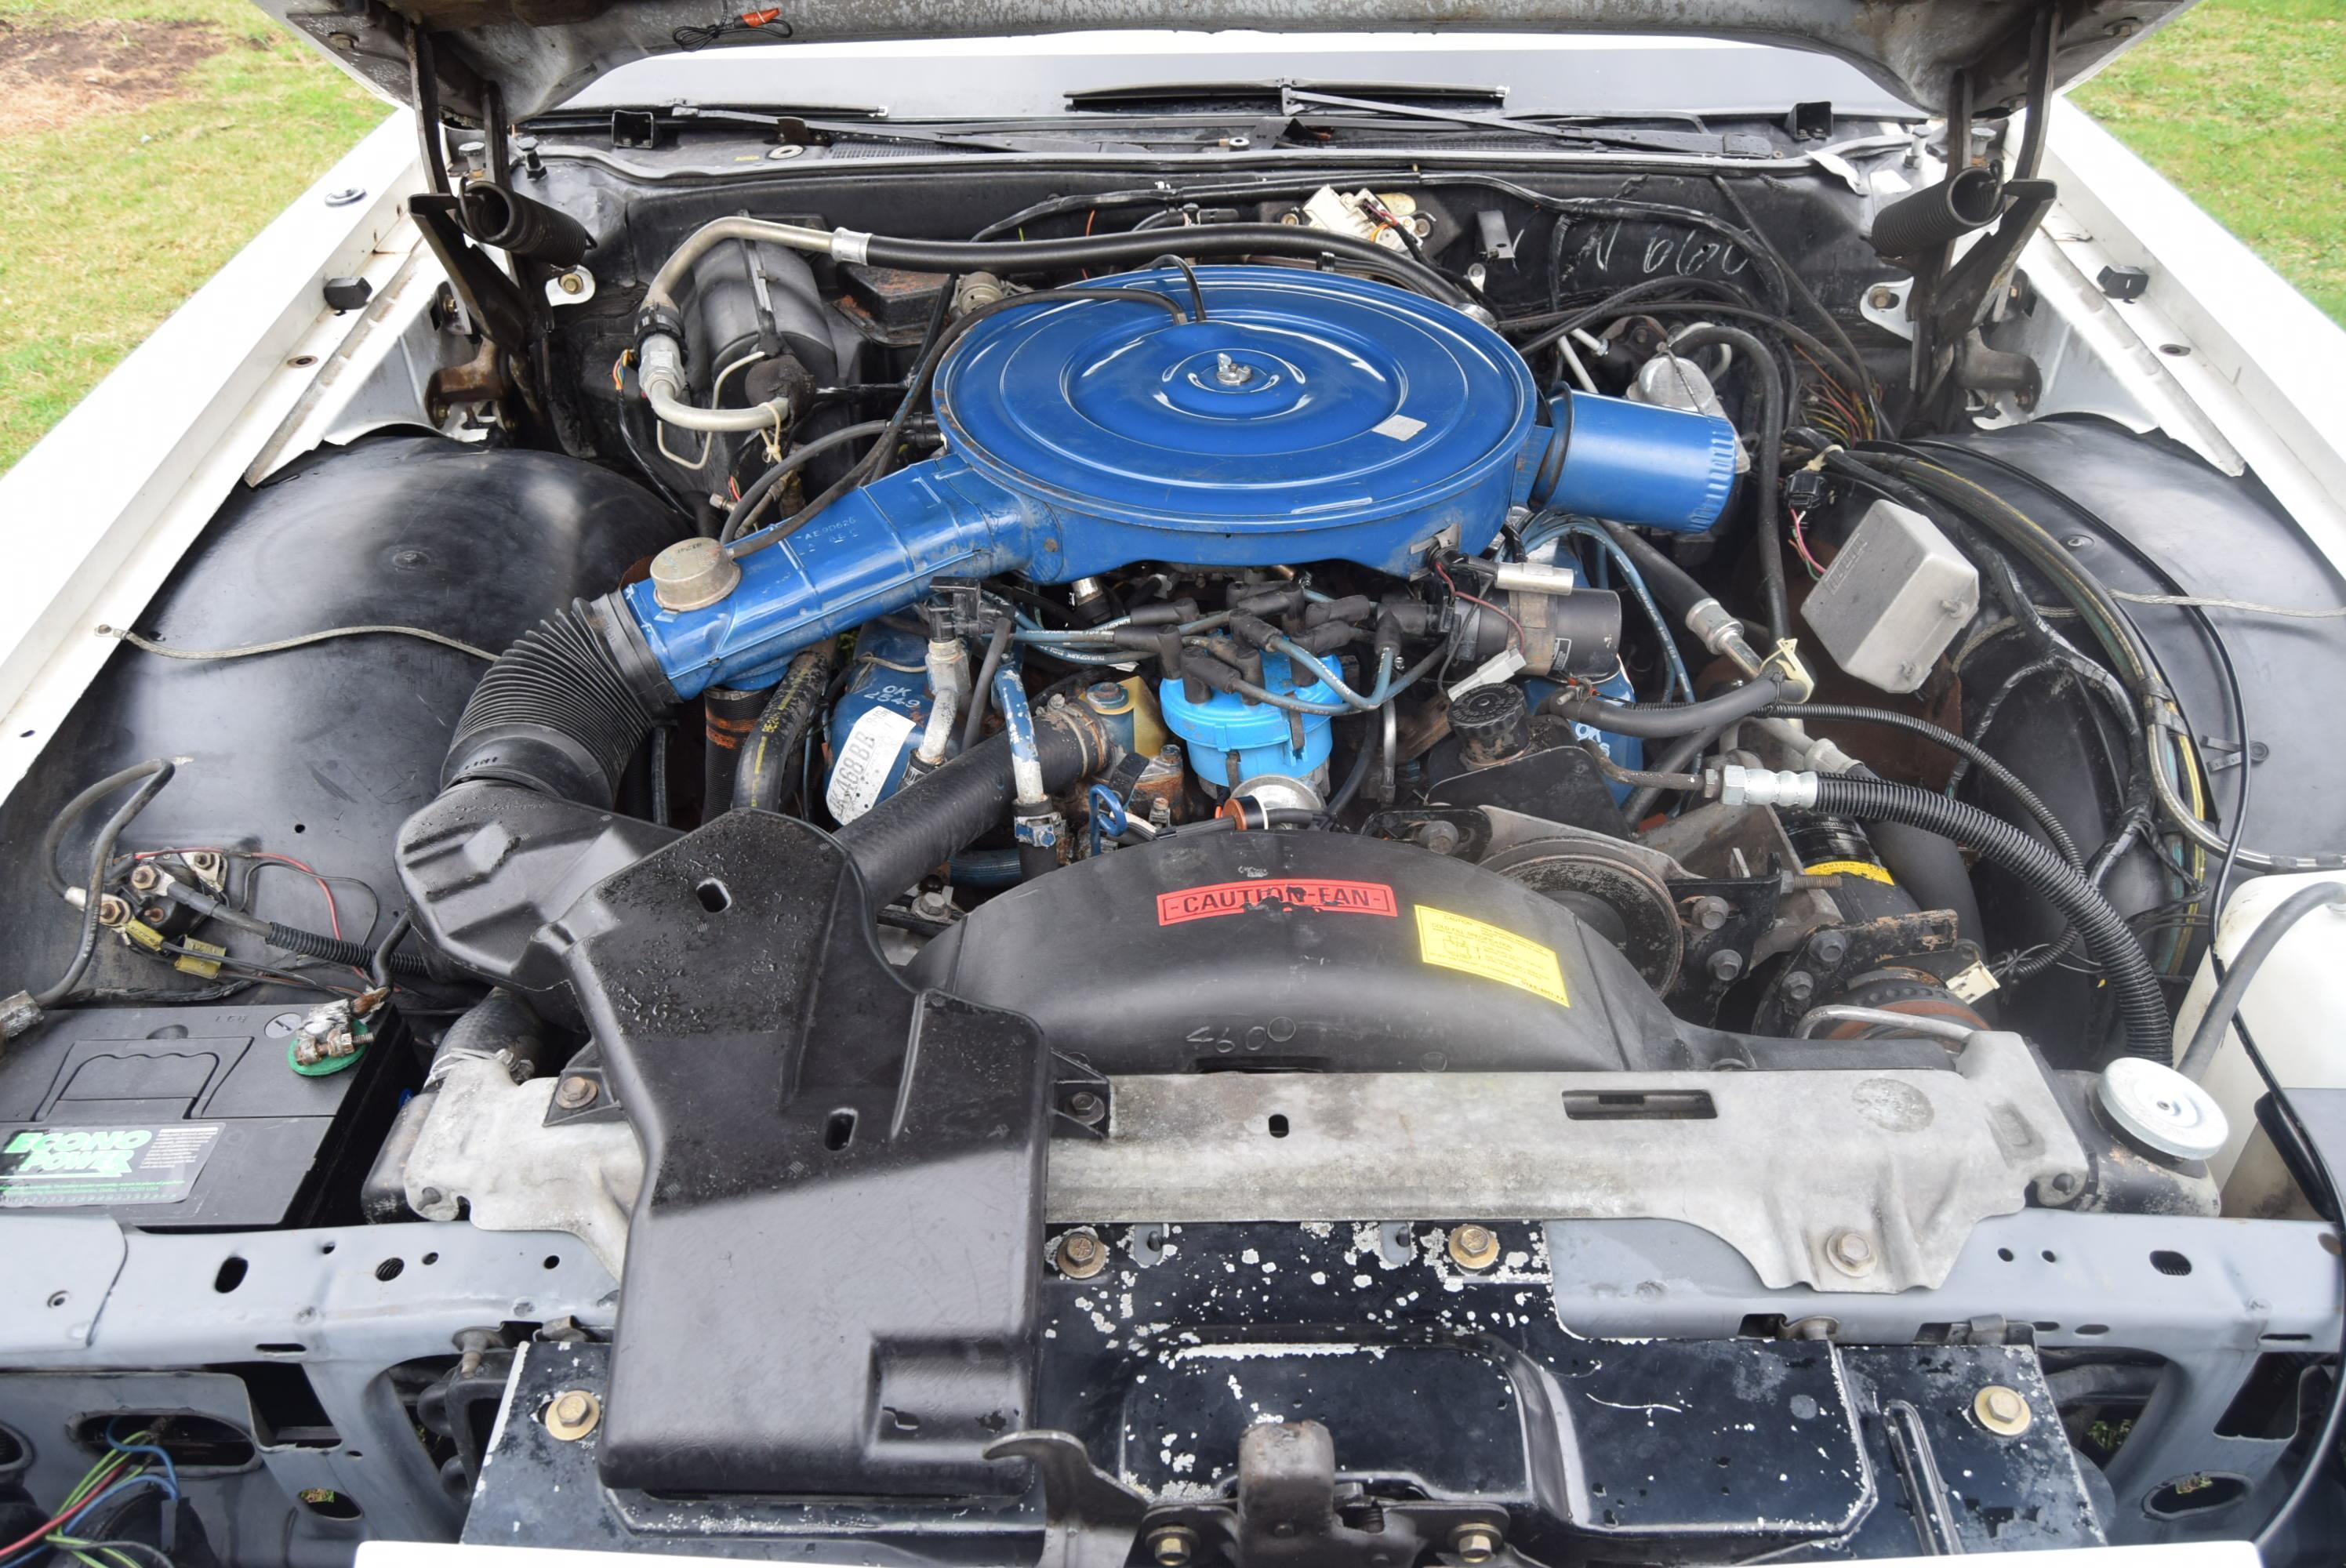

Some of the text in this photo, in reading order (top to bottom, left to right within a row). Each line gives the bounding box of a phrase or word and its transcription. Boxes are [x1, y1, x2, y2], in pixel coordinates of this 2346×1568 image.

[864, 691, 921, 709] 2549
[882, 685, 912, 697] OK
[3, 1130, 153, 1154] ECONO
[18, 1149, 135, 1174] POWER
